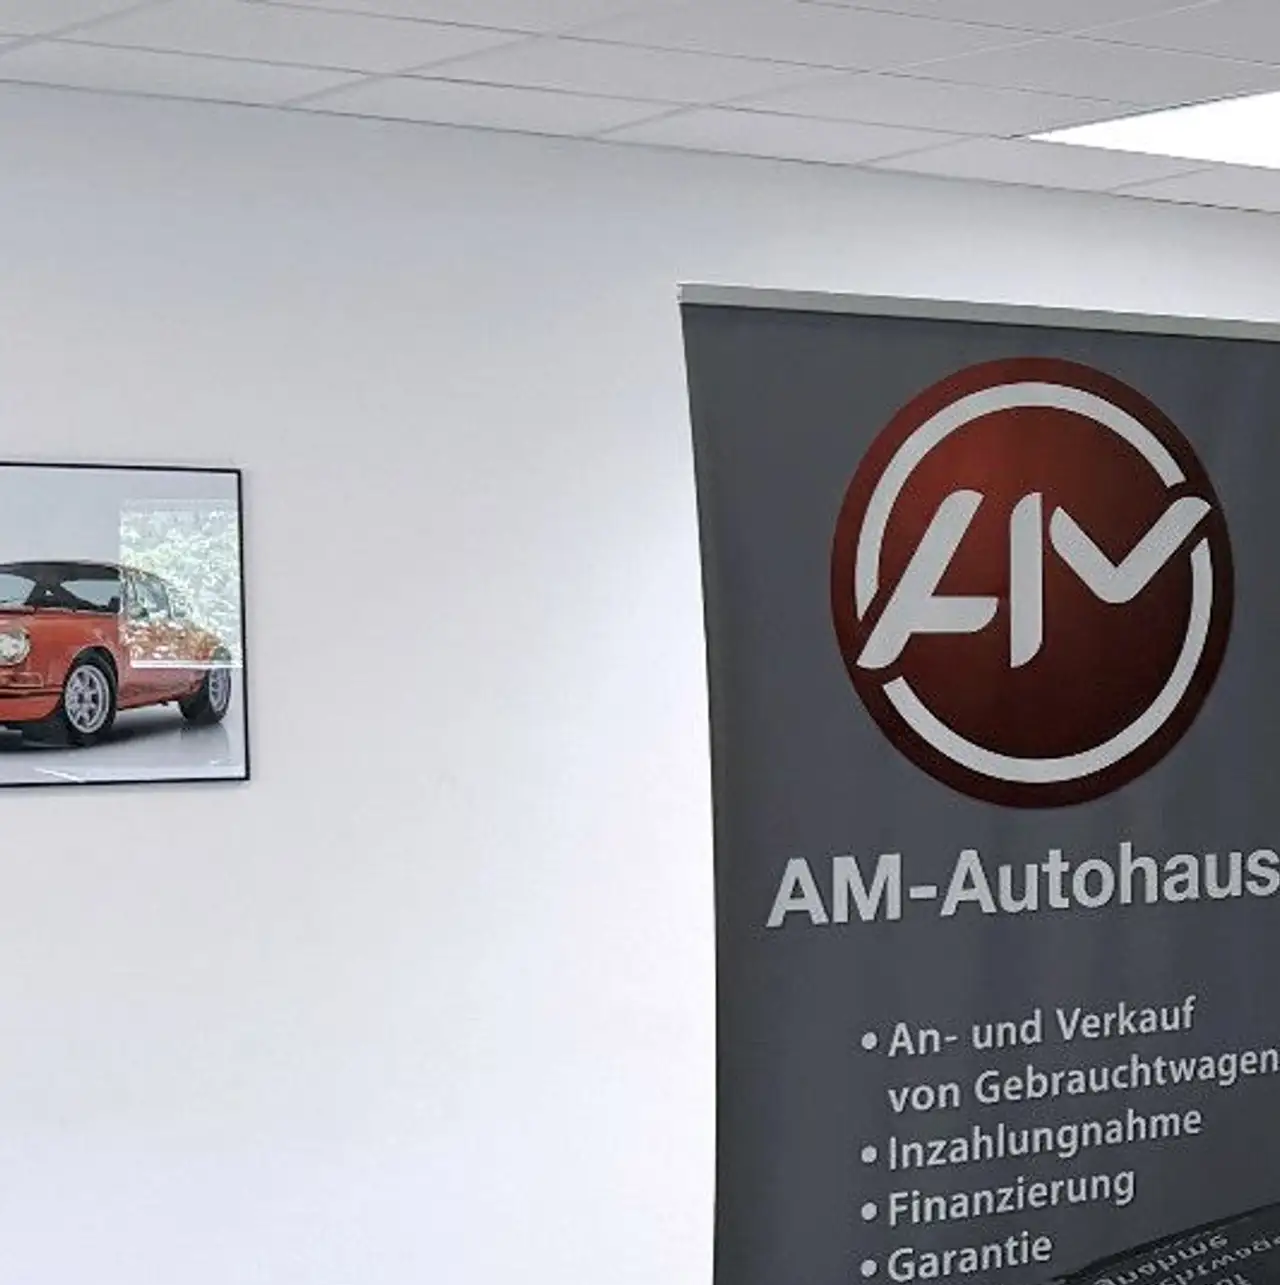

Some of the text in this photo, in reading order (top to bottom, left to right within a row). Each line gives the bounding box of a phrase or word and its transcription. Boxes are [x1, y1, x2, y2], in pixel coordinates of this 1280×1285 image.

[856, 488, 1212, 669] AM
[887, 996, 1197, 1058] An- und Verkauf
[887, 1046, 1280, 1113] von Gebrauchtwagen
[888, 1107, 1202, 1171] Inzahlungnahme
[887, 1168, 1136, 1226] Finanzierung
[887, 1230, 1052, 1282] Garantie
